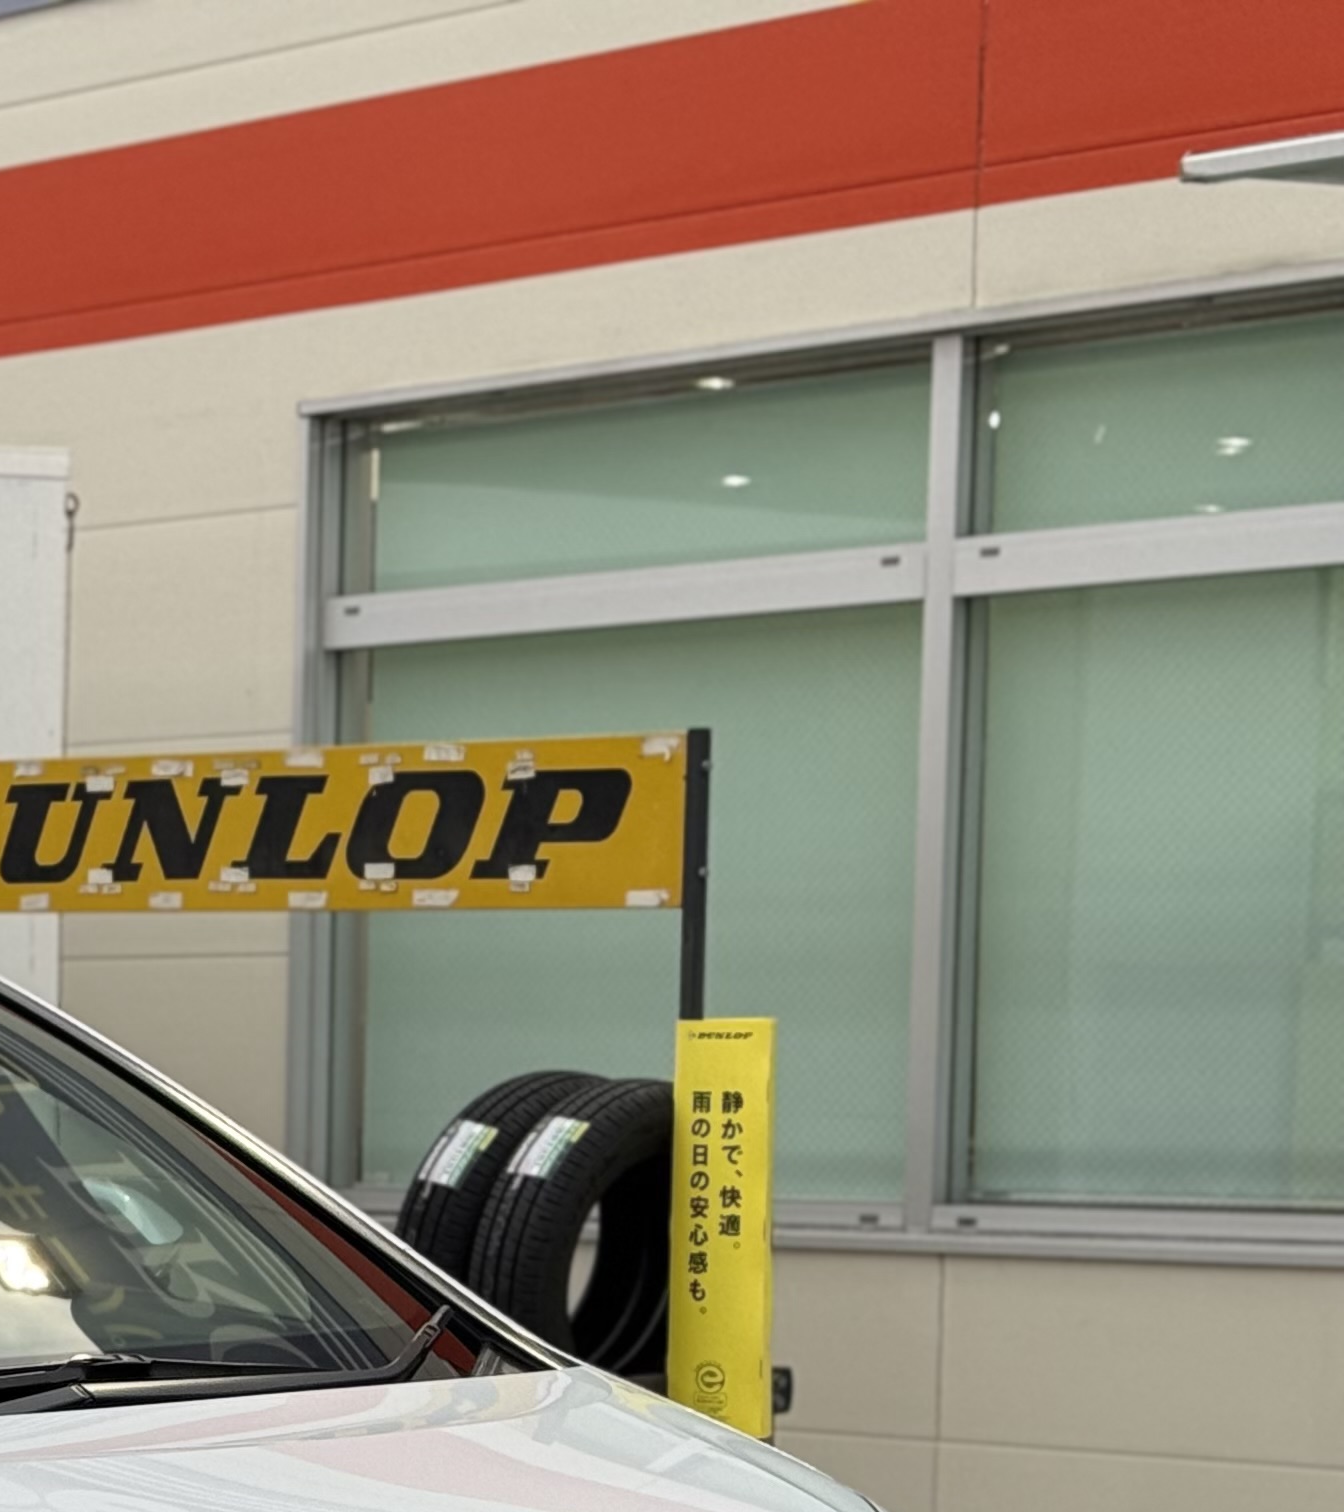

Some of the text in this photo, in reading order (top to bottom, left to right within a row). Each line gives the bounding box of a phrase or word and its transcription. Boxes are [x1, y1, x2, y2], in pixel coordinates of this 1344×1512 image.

[697, 1031, 754, 1040] DUNLOP
[688, 1091, 712, 1315] 雨の日の安心感も。
[718, 1091, 745, 1250] 静かで、快適。
